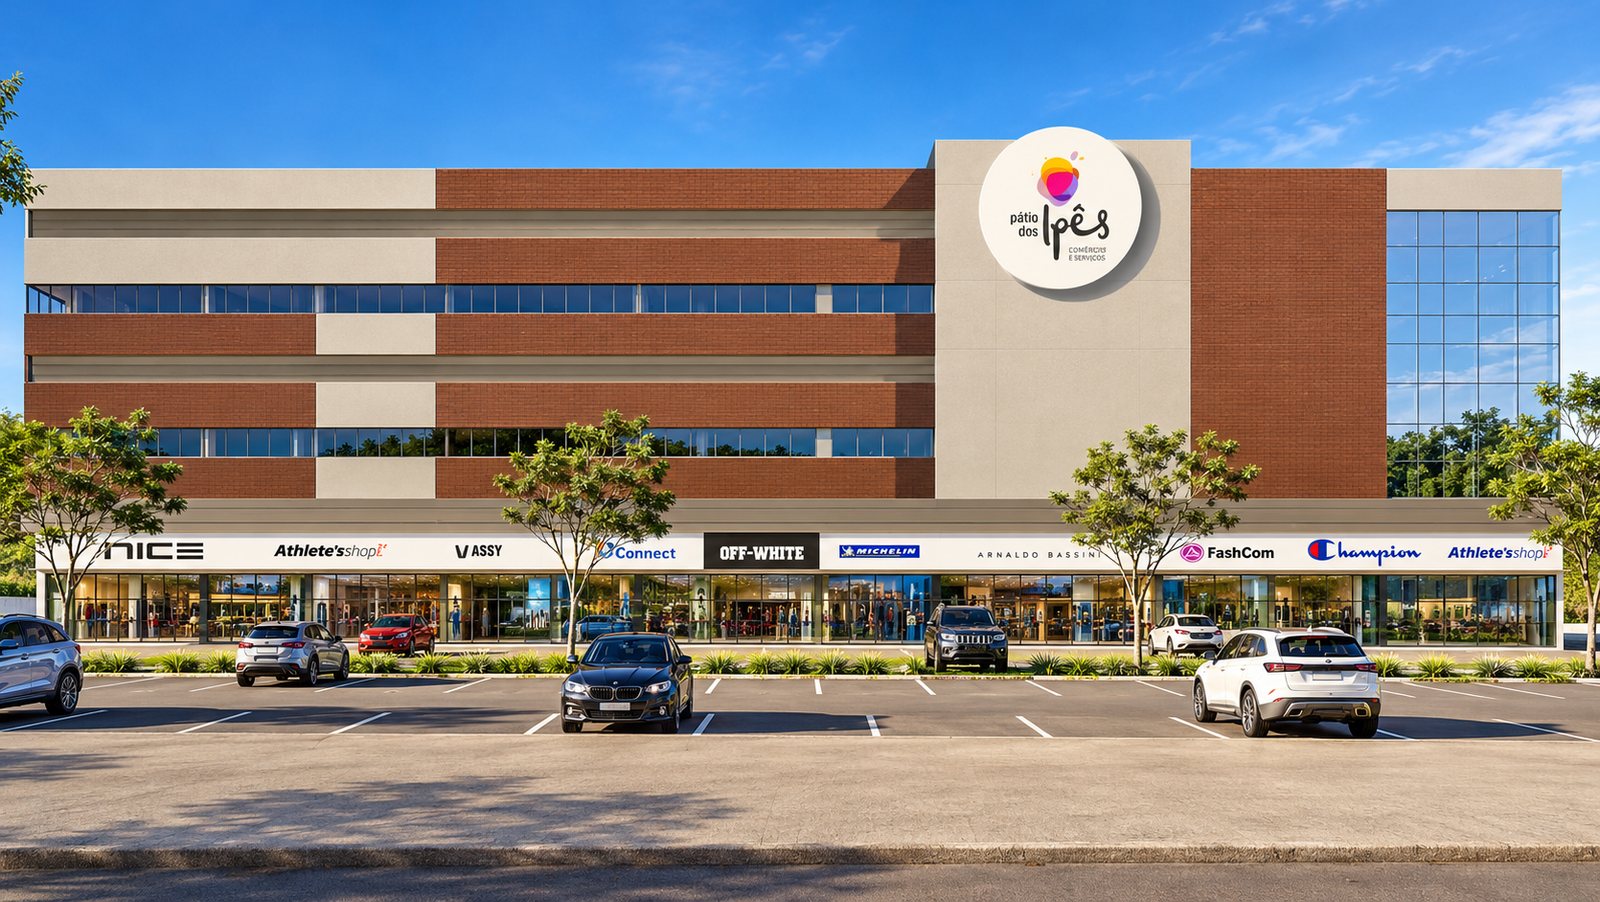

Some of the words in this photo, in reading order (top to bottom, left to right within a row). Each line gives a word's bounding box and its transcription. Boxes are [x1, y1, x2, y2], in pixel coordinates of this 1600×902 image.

[1010, 211, 1039, 225] pátio
[1018, 225, 1039, 237] dos
[1042, 203, 1110, 261] Ipês
[471, 544, 503, 557] ASSY
[615, 547, 676, 559] Connect
[719, 545, 805, 560] OFF-WHITE
[977, 551, 1039, 559] ARNALDO
[1047, 551, 1101, 559] BASSINI
[1207, 547, 1275, 559] FashCom
[1307, 539, 1422, 567] Champion
